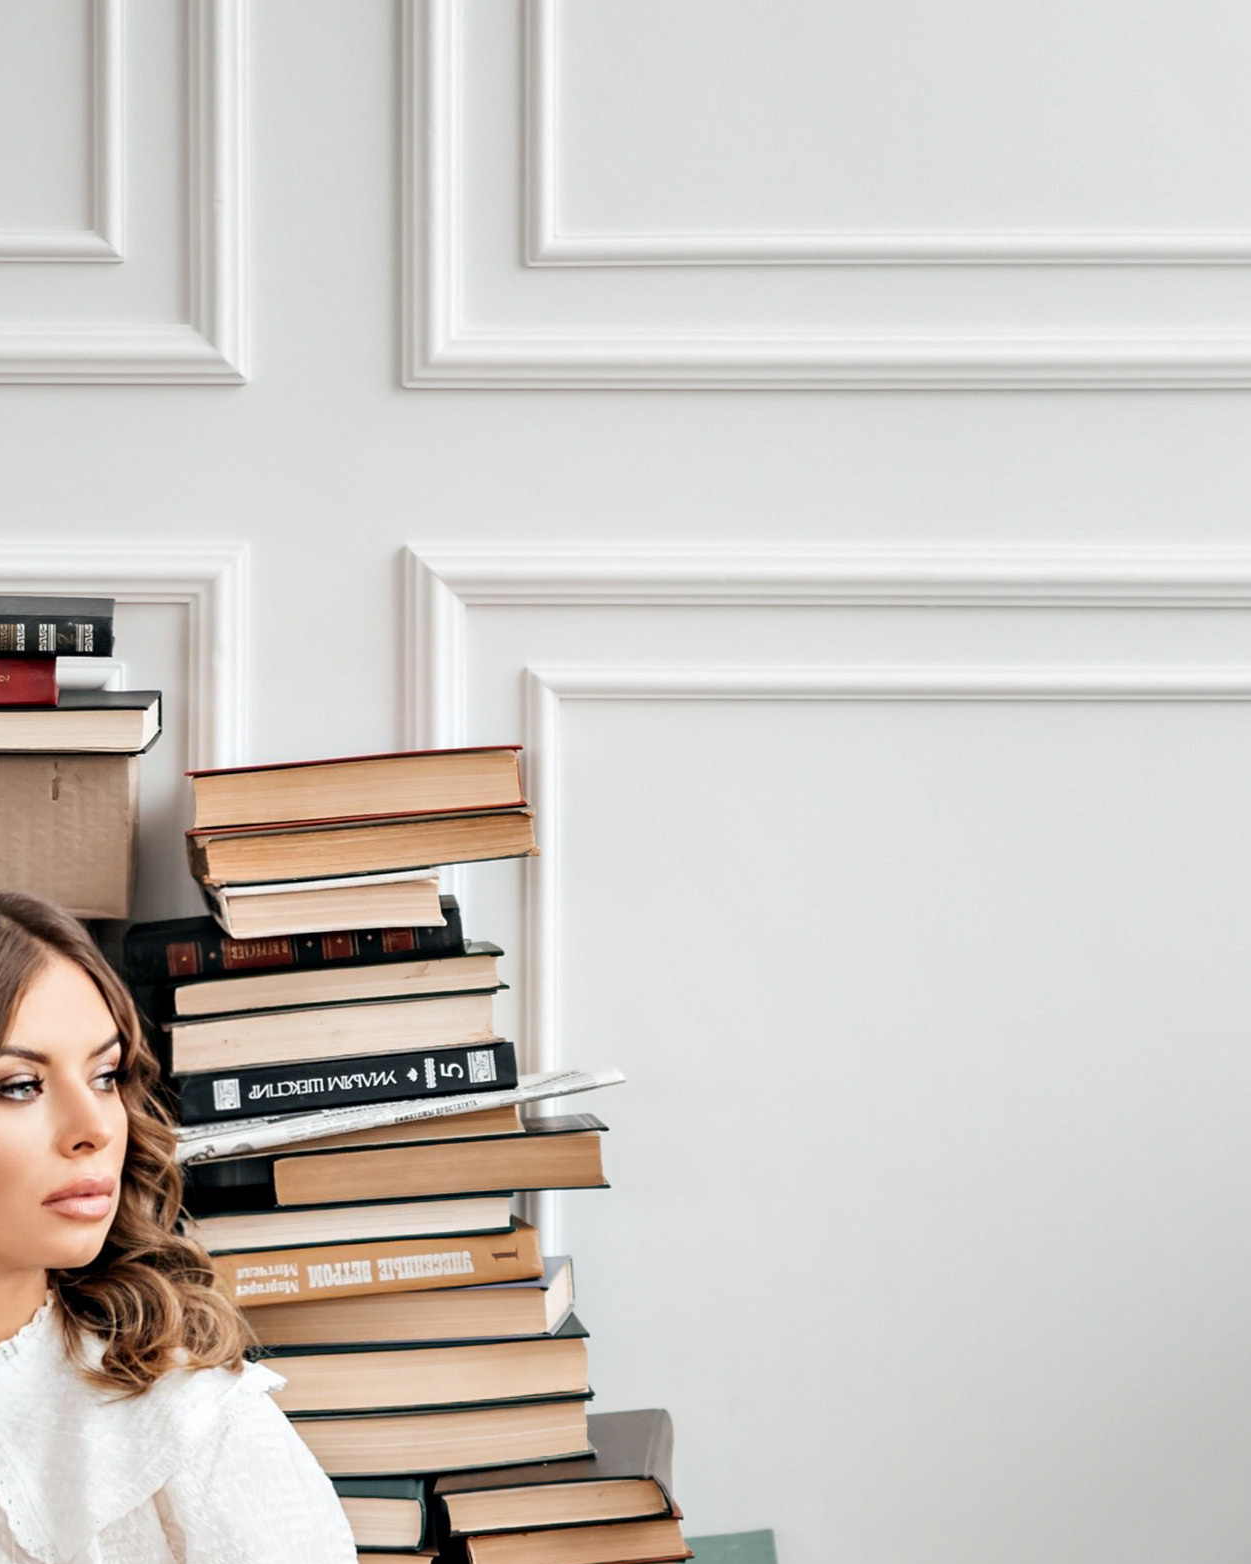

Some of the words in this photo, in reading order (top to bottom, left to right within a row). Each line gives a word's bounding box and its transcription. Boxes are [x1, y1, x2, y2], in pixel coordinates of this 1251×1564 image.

[327, 1068, 397, 1092] УИЛЬЯМ
[440, 1062, 463, 1079] 5
[248, 1076, 324, 1100] ШЕКСПИР
[377, 1250, 474, 1281] УНЕСЕННЫЕ
[491, 1247, 519, 1262] 1
[235, 1277, 300, 1296] Маргарет
[307, 1261, 372, 1288] ВЕТРОМ
